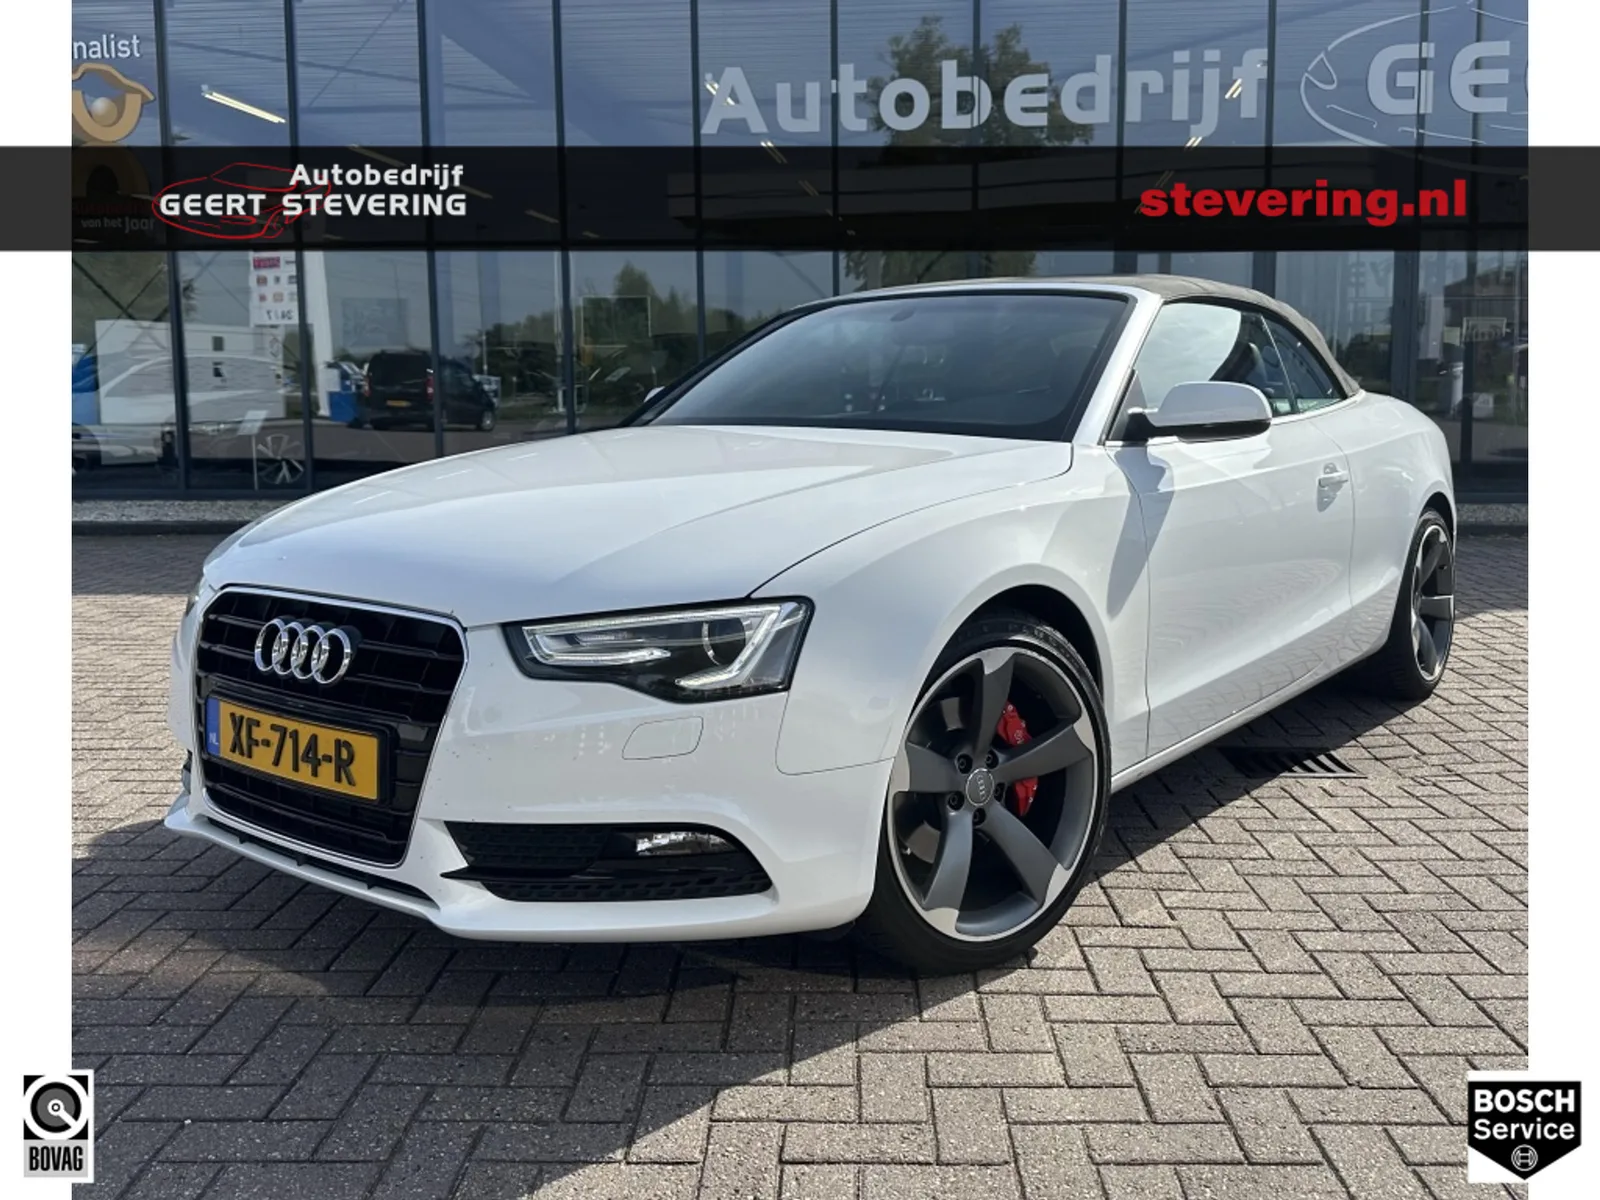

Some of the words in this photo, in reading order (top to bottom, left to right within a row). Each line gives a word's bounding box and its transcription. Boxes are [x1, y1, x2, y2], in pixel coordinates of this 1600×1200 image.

[73, 34, 141, 59] nalist
[701, 48, 1268, 138] Autobedrijf
[1367, 40, 1528, 115] GE
[209, 732, 219, 745] NL
[229, 711, 357, 787] XF-714-R
